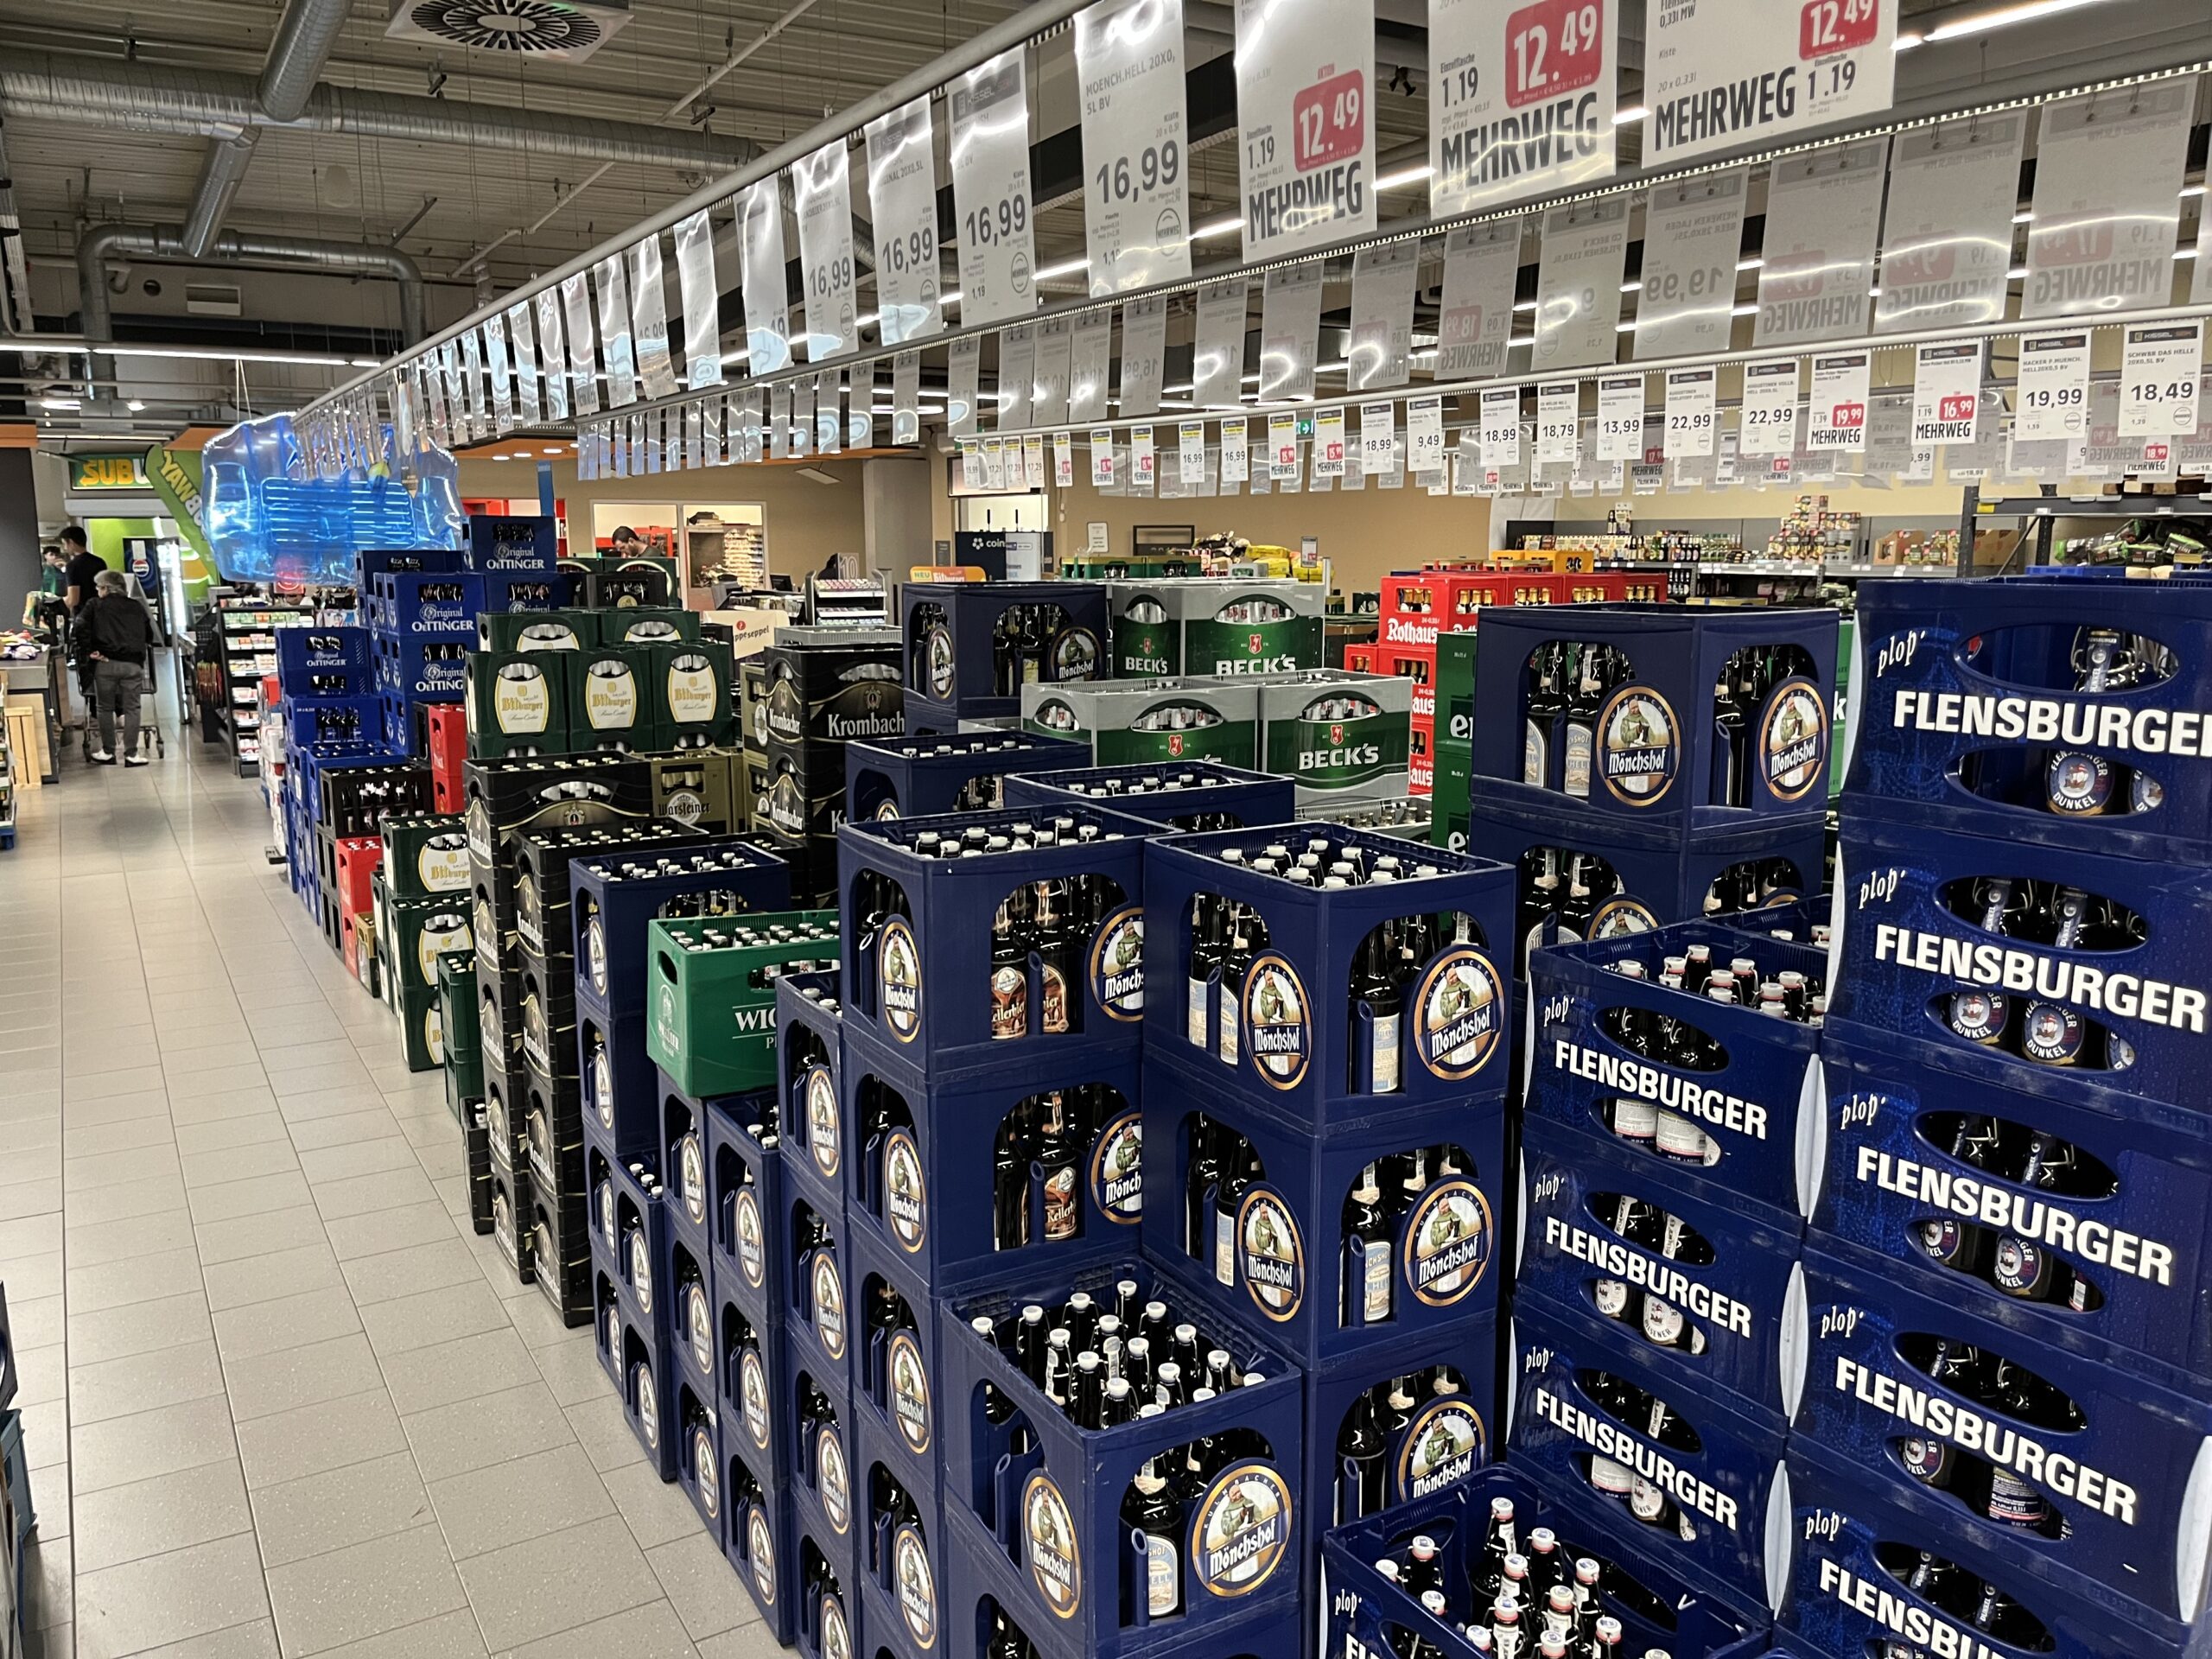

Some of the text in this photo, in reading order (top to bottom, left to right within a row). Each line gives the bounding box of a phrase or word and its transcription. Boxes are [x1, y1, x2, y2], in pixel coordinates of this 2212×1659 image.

[1514, 4, 1597, 92] 12.49
[1442, 67, 1478, 108] 1.19
[1808, 60, 1856, 100] 1.19
[1086, 96, 1111, 116] 5L BV
[1655, 66, 1796, 151] MEHRWEG
[1300, 87, 1360, 159] 12.49
[1248, 136, 1275, 170] 1.19
[1441, 92, 1598, 194] MEHRWEG
[1096, 140, 1179, 205] 16,99
[1249, 161, 1362, 242] MEHRWEG
[966, 194, 1027, 247] 16,99
[883, 226, 933, 274] 16,99
[809, 256, 851, 298] 16,99
[2025, 389, 2082, 409] 19,99
[2131, 382, 2194, 403] 18,49
[1749, 408, 1792, 425] 22,99
[1836, 407, 1862, 424] 19.99
[1943, 400, 1972, 419] 16.99
[1543, 424, 1574, 438] 18,79
[1604, 419, 1639, 434] 13,99
[1672, 414, 1711, 430] 22,99
[1916, 422, 1971, 439] MEHRWEG
[1366, 439, 1391, 451] 18,99
[1418, 435, 1440, 448] 9,49
[1485, 429, 1516, 443] 18,99
[1811, 428, 1860, 445] MEHRWEG
[1183, 454, 1203, 464] 16,99
[1225, 451, 1245, 461] 16,99
[1317, 460, 1344, 473] MEHRWEG
[1271, 463, 1295, 476] MEHRWEG
[1631, 464, 1663, 477] MEHRWEG
[913, 570, 931, 579] NEU
[1386, 618, 1439, 645] Rothaus
[1125, 657, 1168, 674] BECK'S
[1216, 654, 1296, 676] BECK'S
[415, 680, 464, 693] OETTING
[674, 686, 712, 702] Bitburger
[501, 696, 543, 712] Bitburger
[592, 692, 632, 708] Bitburger
[828, 710, 906, 737] Krombach
[1299, 743, 1379, 771] BECK'S
[1609, 749, 1666, 775] Mönchshof
[1771, 739, 1816, 776] Mönchshof
[658, 802, 712, 817] Warsteiner
[2053, 791, 2097, 810] DUNKEL
[430, 866, 472, 880] Bitburge
[1875, 924, 2207, 1033] FLENSBURGER
[1255, 1025, 1300, 1053] Mönchshof
[1432, 1007, 1491, 1058] Mönchshof
[1951, 1018, 1993, 1040] DUNKEL
[2026, 1038, 2067, 1060] DUNKEL
[1555, 1039, 1767, 1141] FLENSBURGER
[1105, 1174, 1142, 1205] Mönch
[1856, 1146, 2175, 1287] FLENSBURGER
[1419, 1232, 1478, 1286] Mönchshof
[1248, 1255, 1293, 1287] Mönchshof
[1547, 1216, 1751, 1338] FLENSBURGER
[1835, 1355, 2139, 1527] FLENSBURGER
[1536, 1388, 1738, 1532] FLENSBURGER
[1414, 1451, 1472, 1498] Mönchshof
[1210, 1517, 1277, 1579] Mönchshof
[1033, 1541, 1072, 1586] Mönchshof
[1148, 1573, 1172, 1587] ELL
